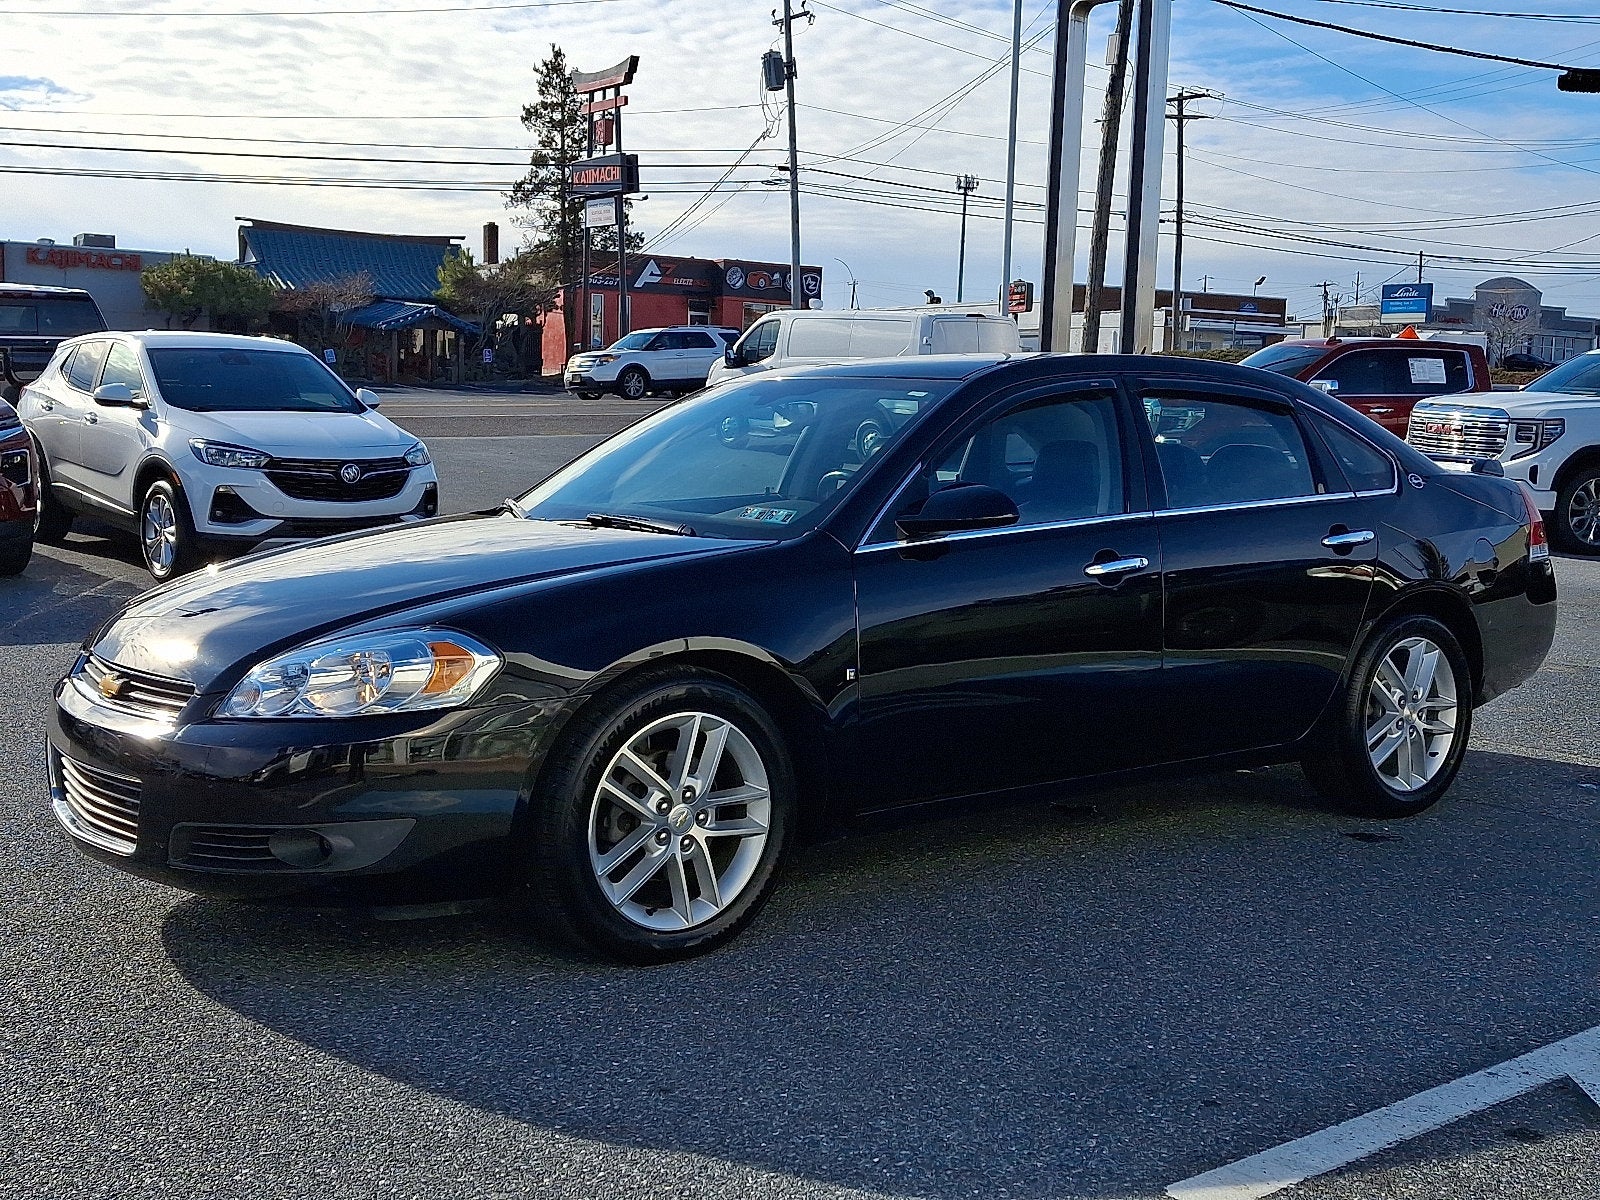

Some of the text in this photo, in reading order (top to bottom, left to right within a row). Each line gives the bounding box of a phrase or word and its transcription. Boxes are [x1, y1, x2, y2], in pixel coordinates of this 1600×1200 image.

[573, 166, 620, 186] KAJIMACHI
[26, 247, 142, 271] KAJIMACHI
[1390, 286, 1419, 298] Linde
[1427, 423, 1462, 436] GMC
